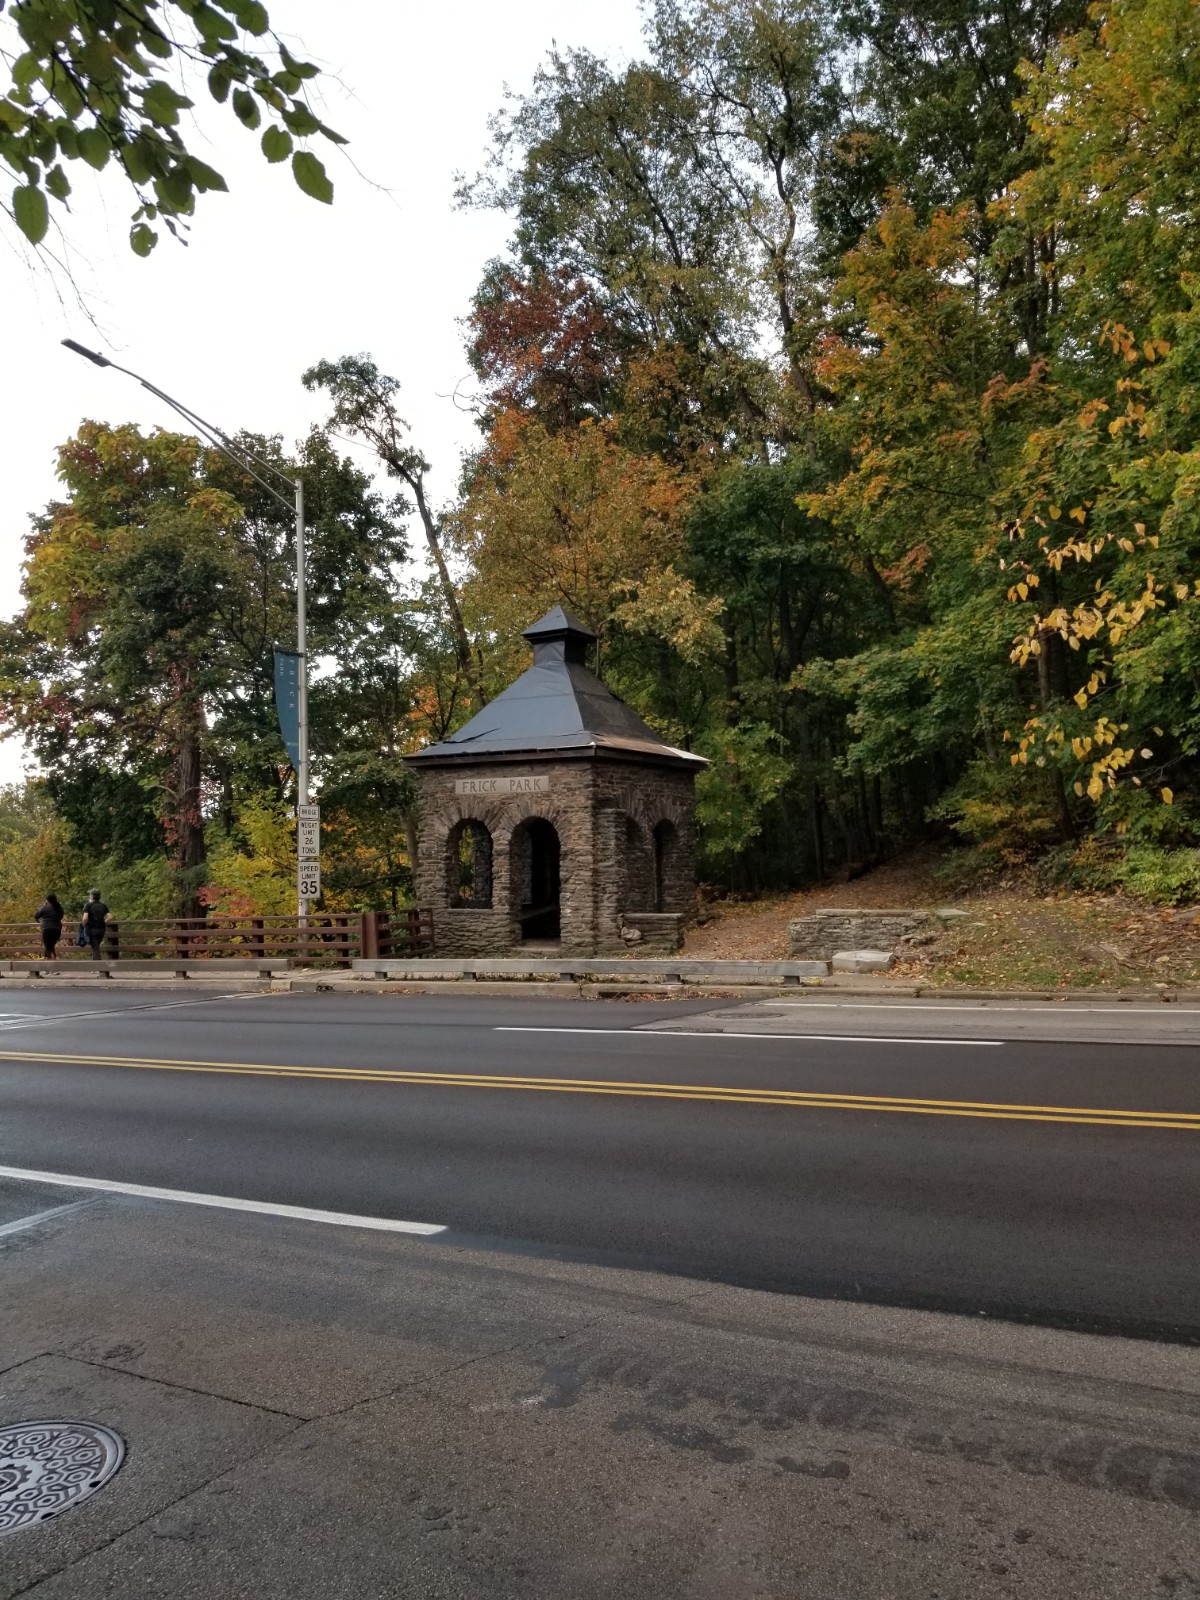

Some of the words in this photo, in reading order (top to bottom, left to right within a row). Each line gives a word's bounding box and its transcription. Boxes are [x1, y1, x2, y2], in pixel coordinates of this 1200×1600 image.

[462, 780, 497, 792] FRICK
[509, 778, 541, 791] PARK
[301, 881, 317, 894] 35
